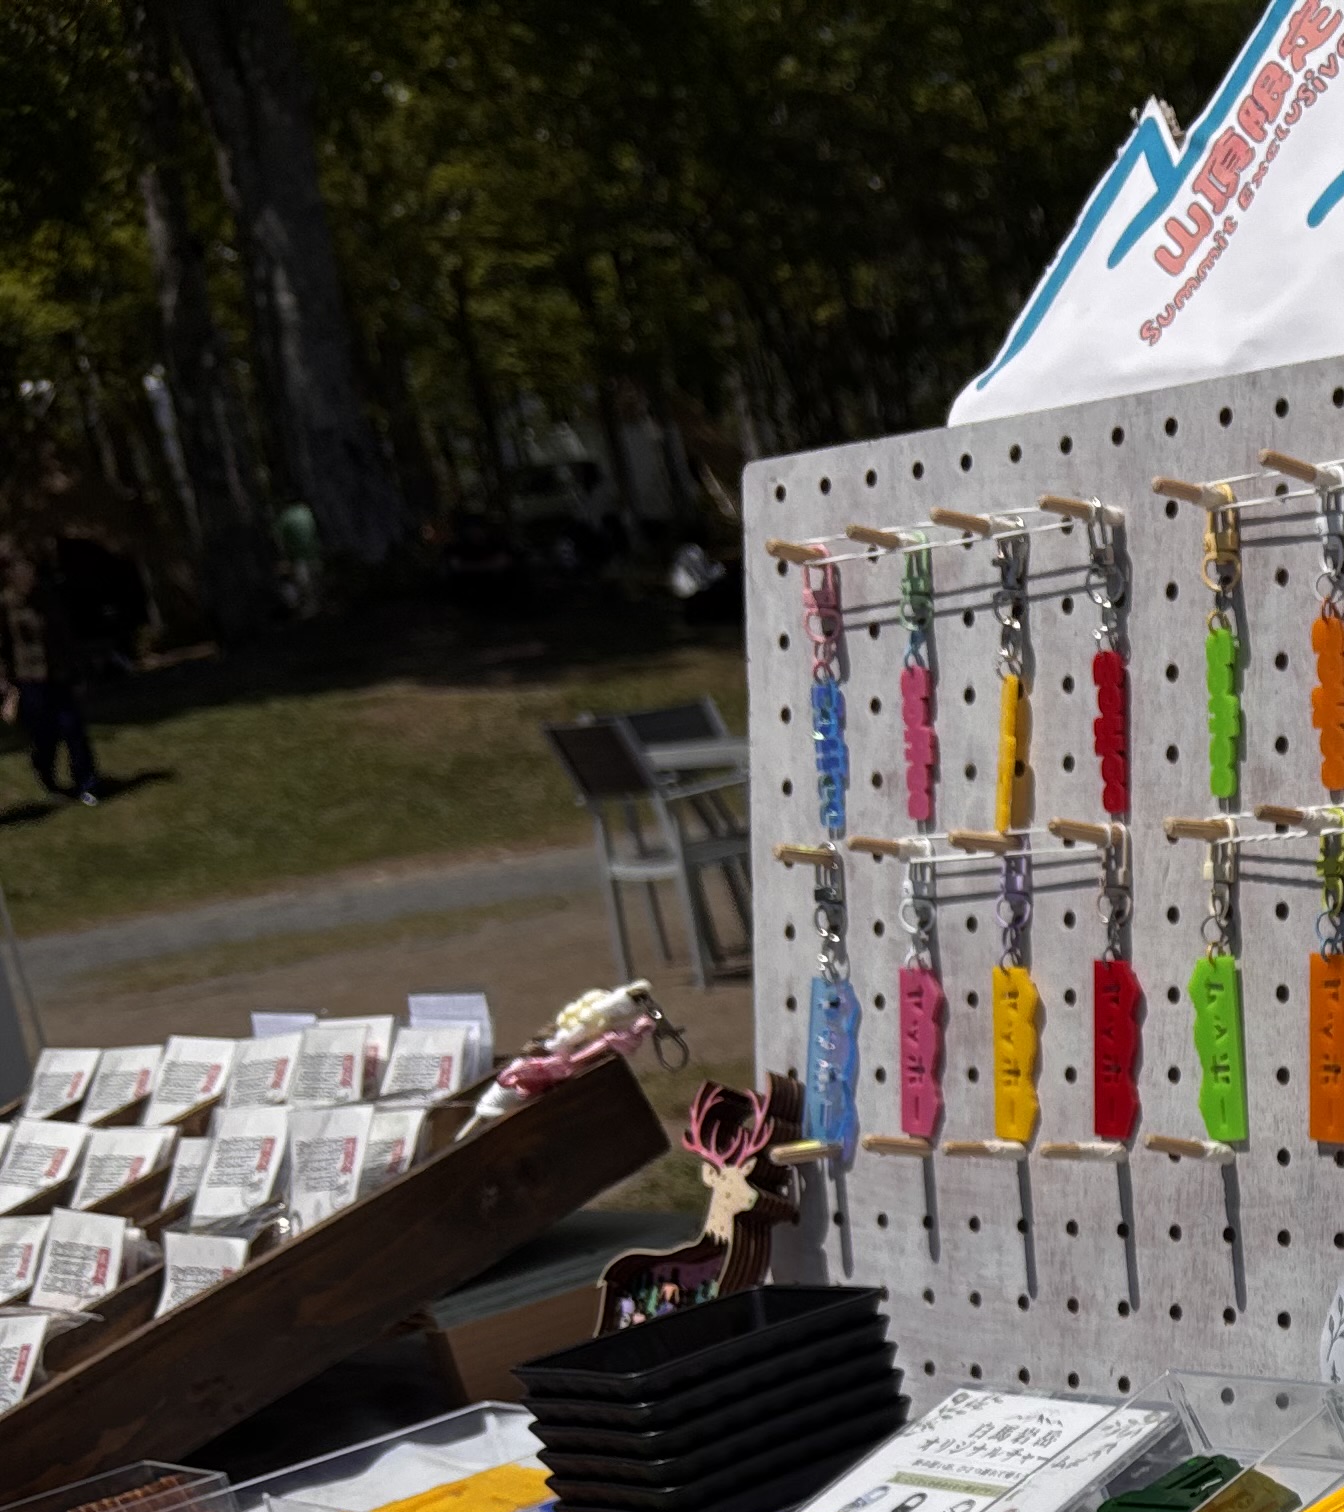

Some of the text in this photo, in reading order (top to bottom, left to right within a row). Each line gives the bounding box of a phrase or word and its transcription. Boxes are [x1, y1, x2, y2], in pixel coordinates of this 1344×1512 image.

[1154, 0, 1344, 276] 山頂限定
[1140, 215, 1238, 346] Summit
